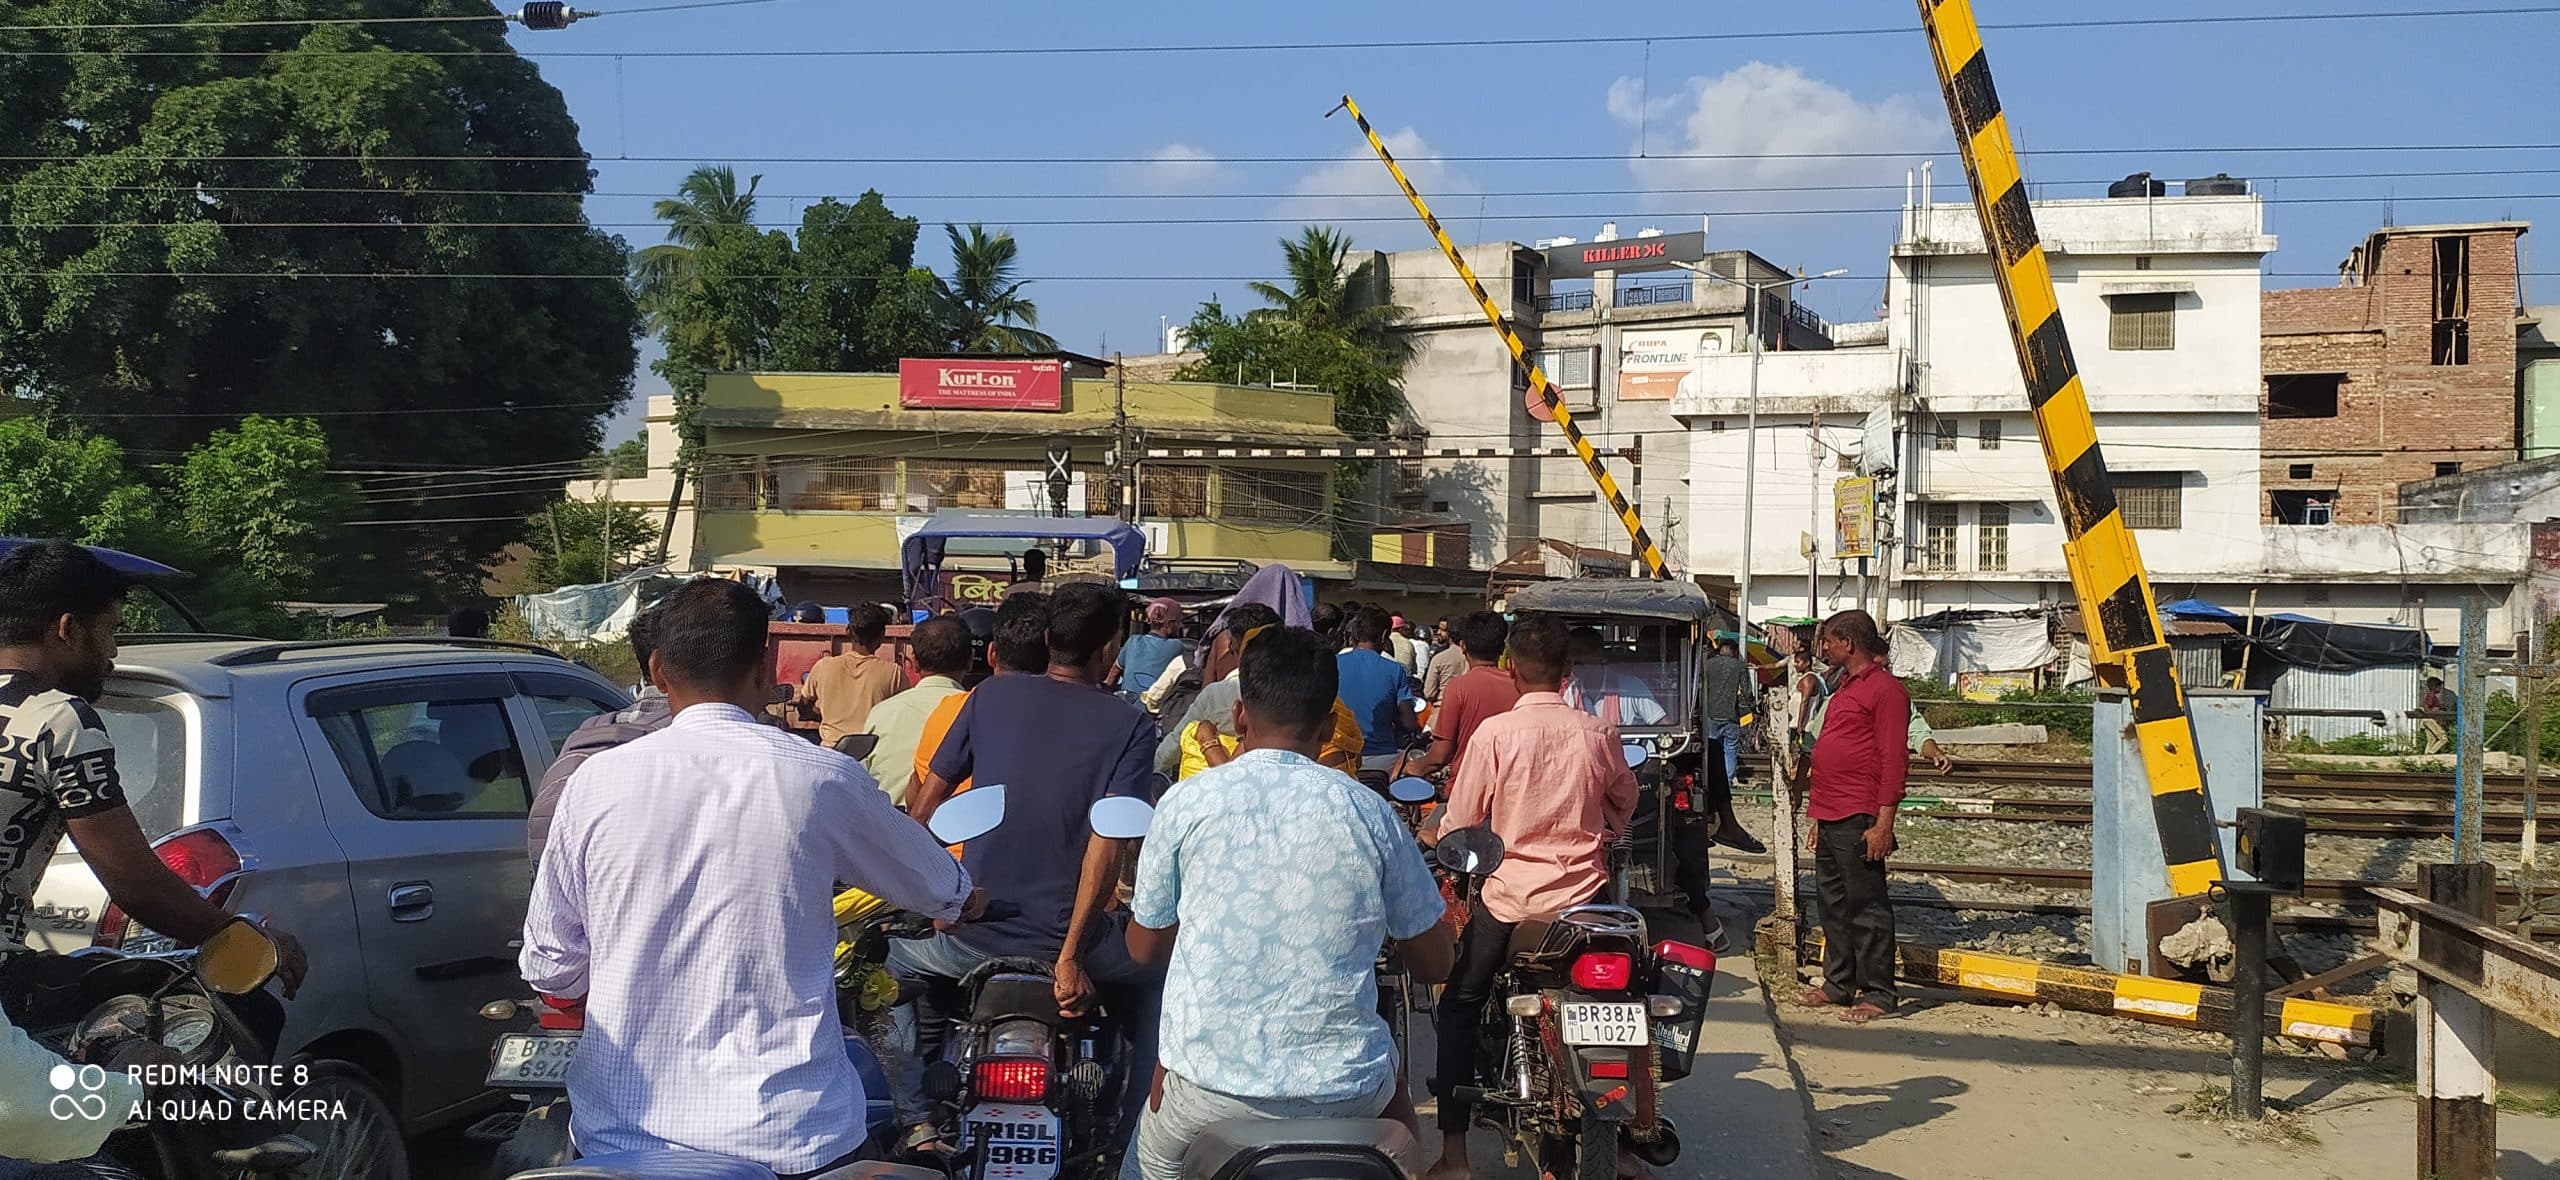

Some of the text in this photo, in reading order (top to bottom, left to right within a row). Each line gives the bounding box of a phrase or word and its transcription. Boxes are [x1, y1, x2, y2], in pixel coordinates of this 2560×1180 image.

[1583, 245, 1641, 263] KILLER
[1627, 352, 1688, 364] FRONTLINE
[938, 369, 1016, 388] Kurl-on
[1579, 1006, 1635, 1023] BR38A
[1580, 1025, 1637, 1042] L1027
[1655, 1021, 1691, 1047] Steelbird
[985, 1146, 1056, 1165] 986
